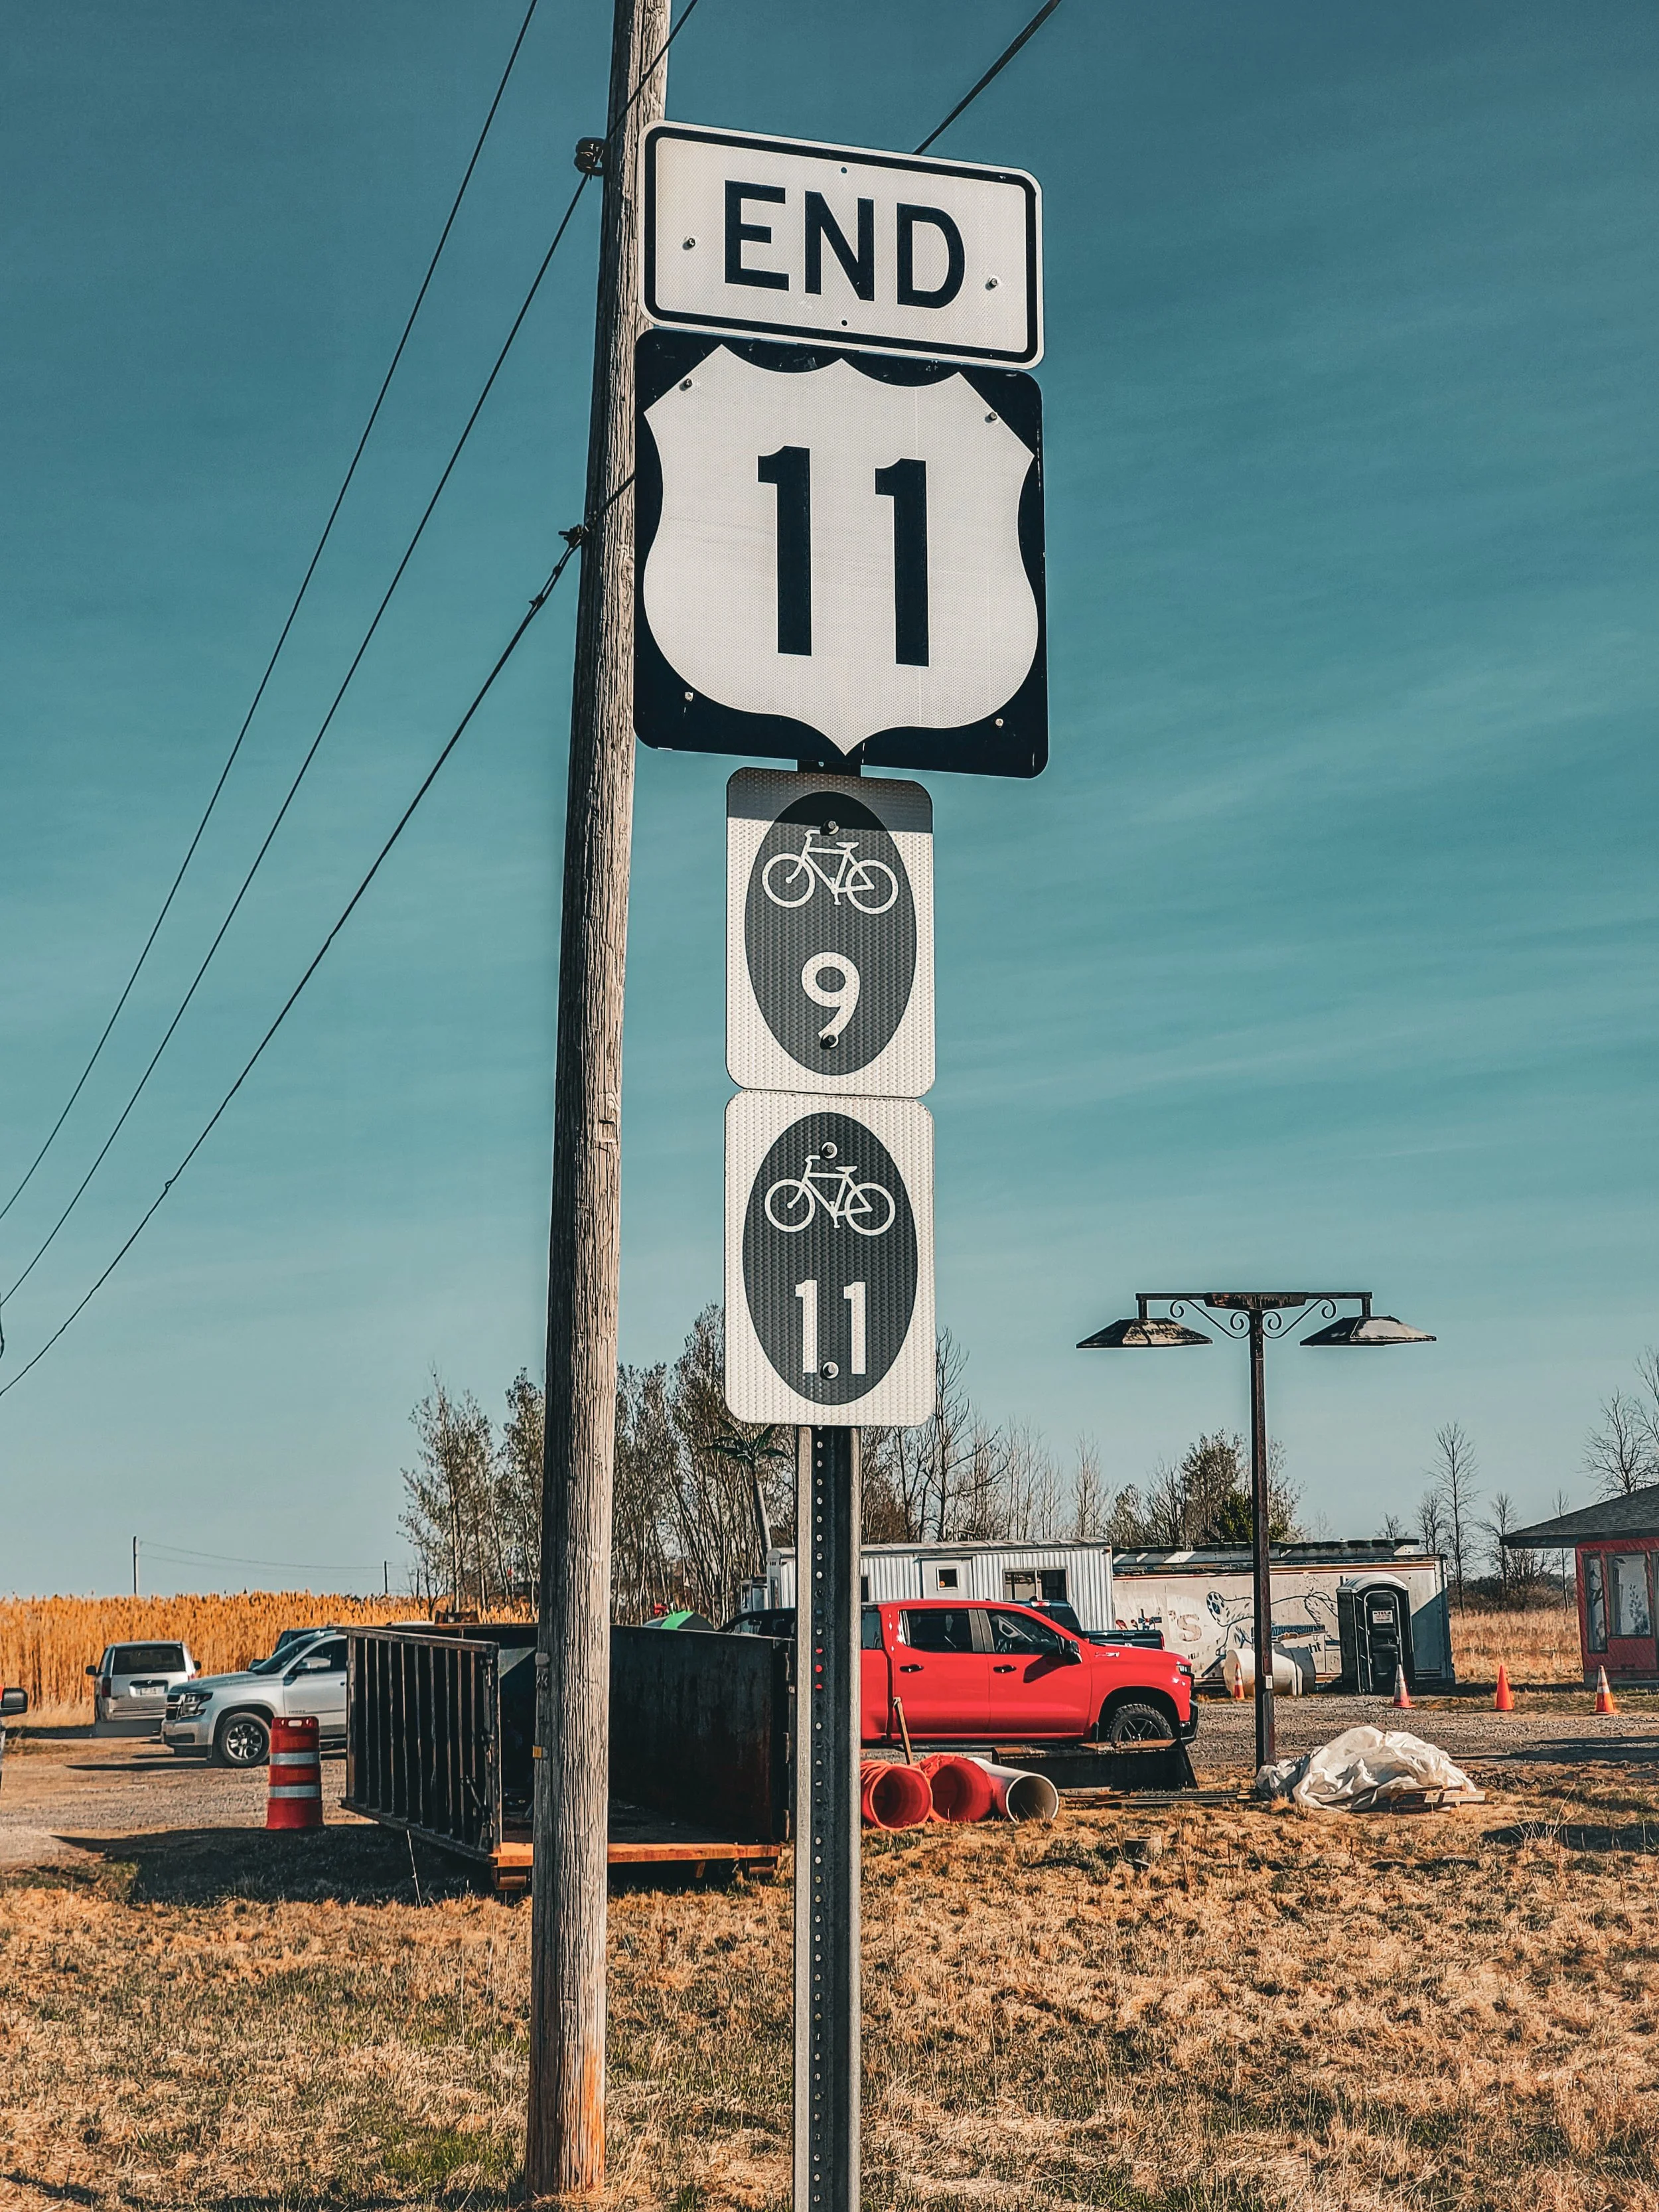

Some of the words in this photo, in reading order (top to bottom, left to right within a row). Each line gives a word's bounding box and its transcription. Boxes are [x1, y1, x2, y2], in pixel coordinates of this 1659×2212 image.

[724, 179, 966, 309] END
[757, 445, 930, 668] 11
[801, 951, 861, 1045] 9
[795, 1279, 866, 1374] 11
